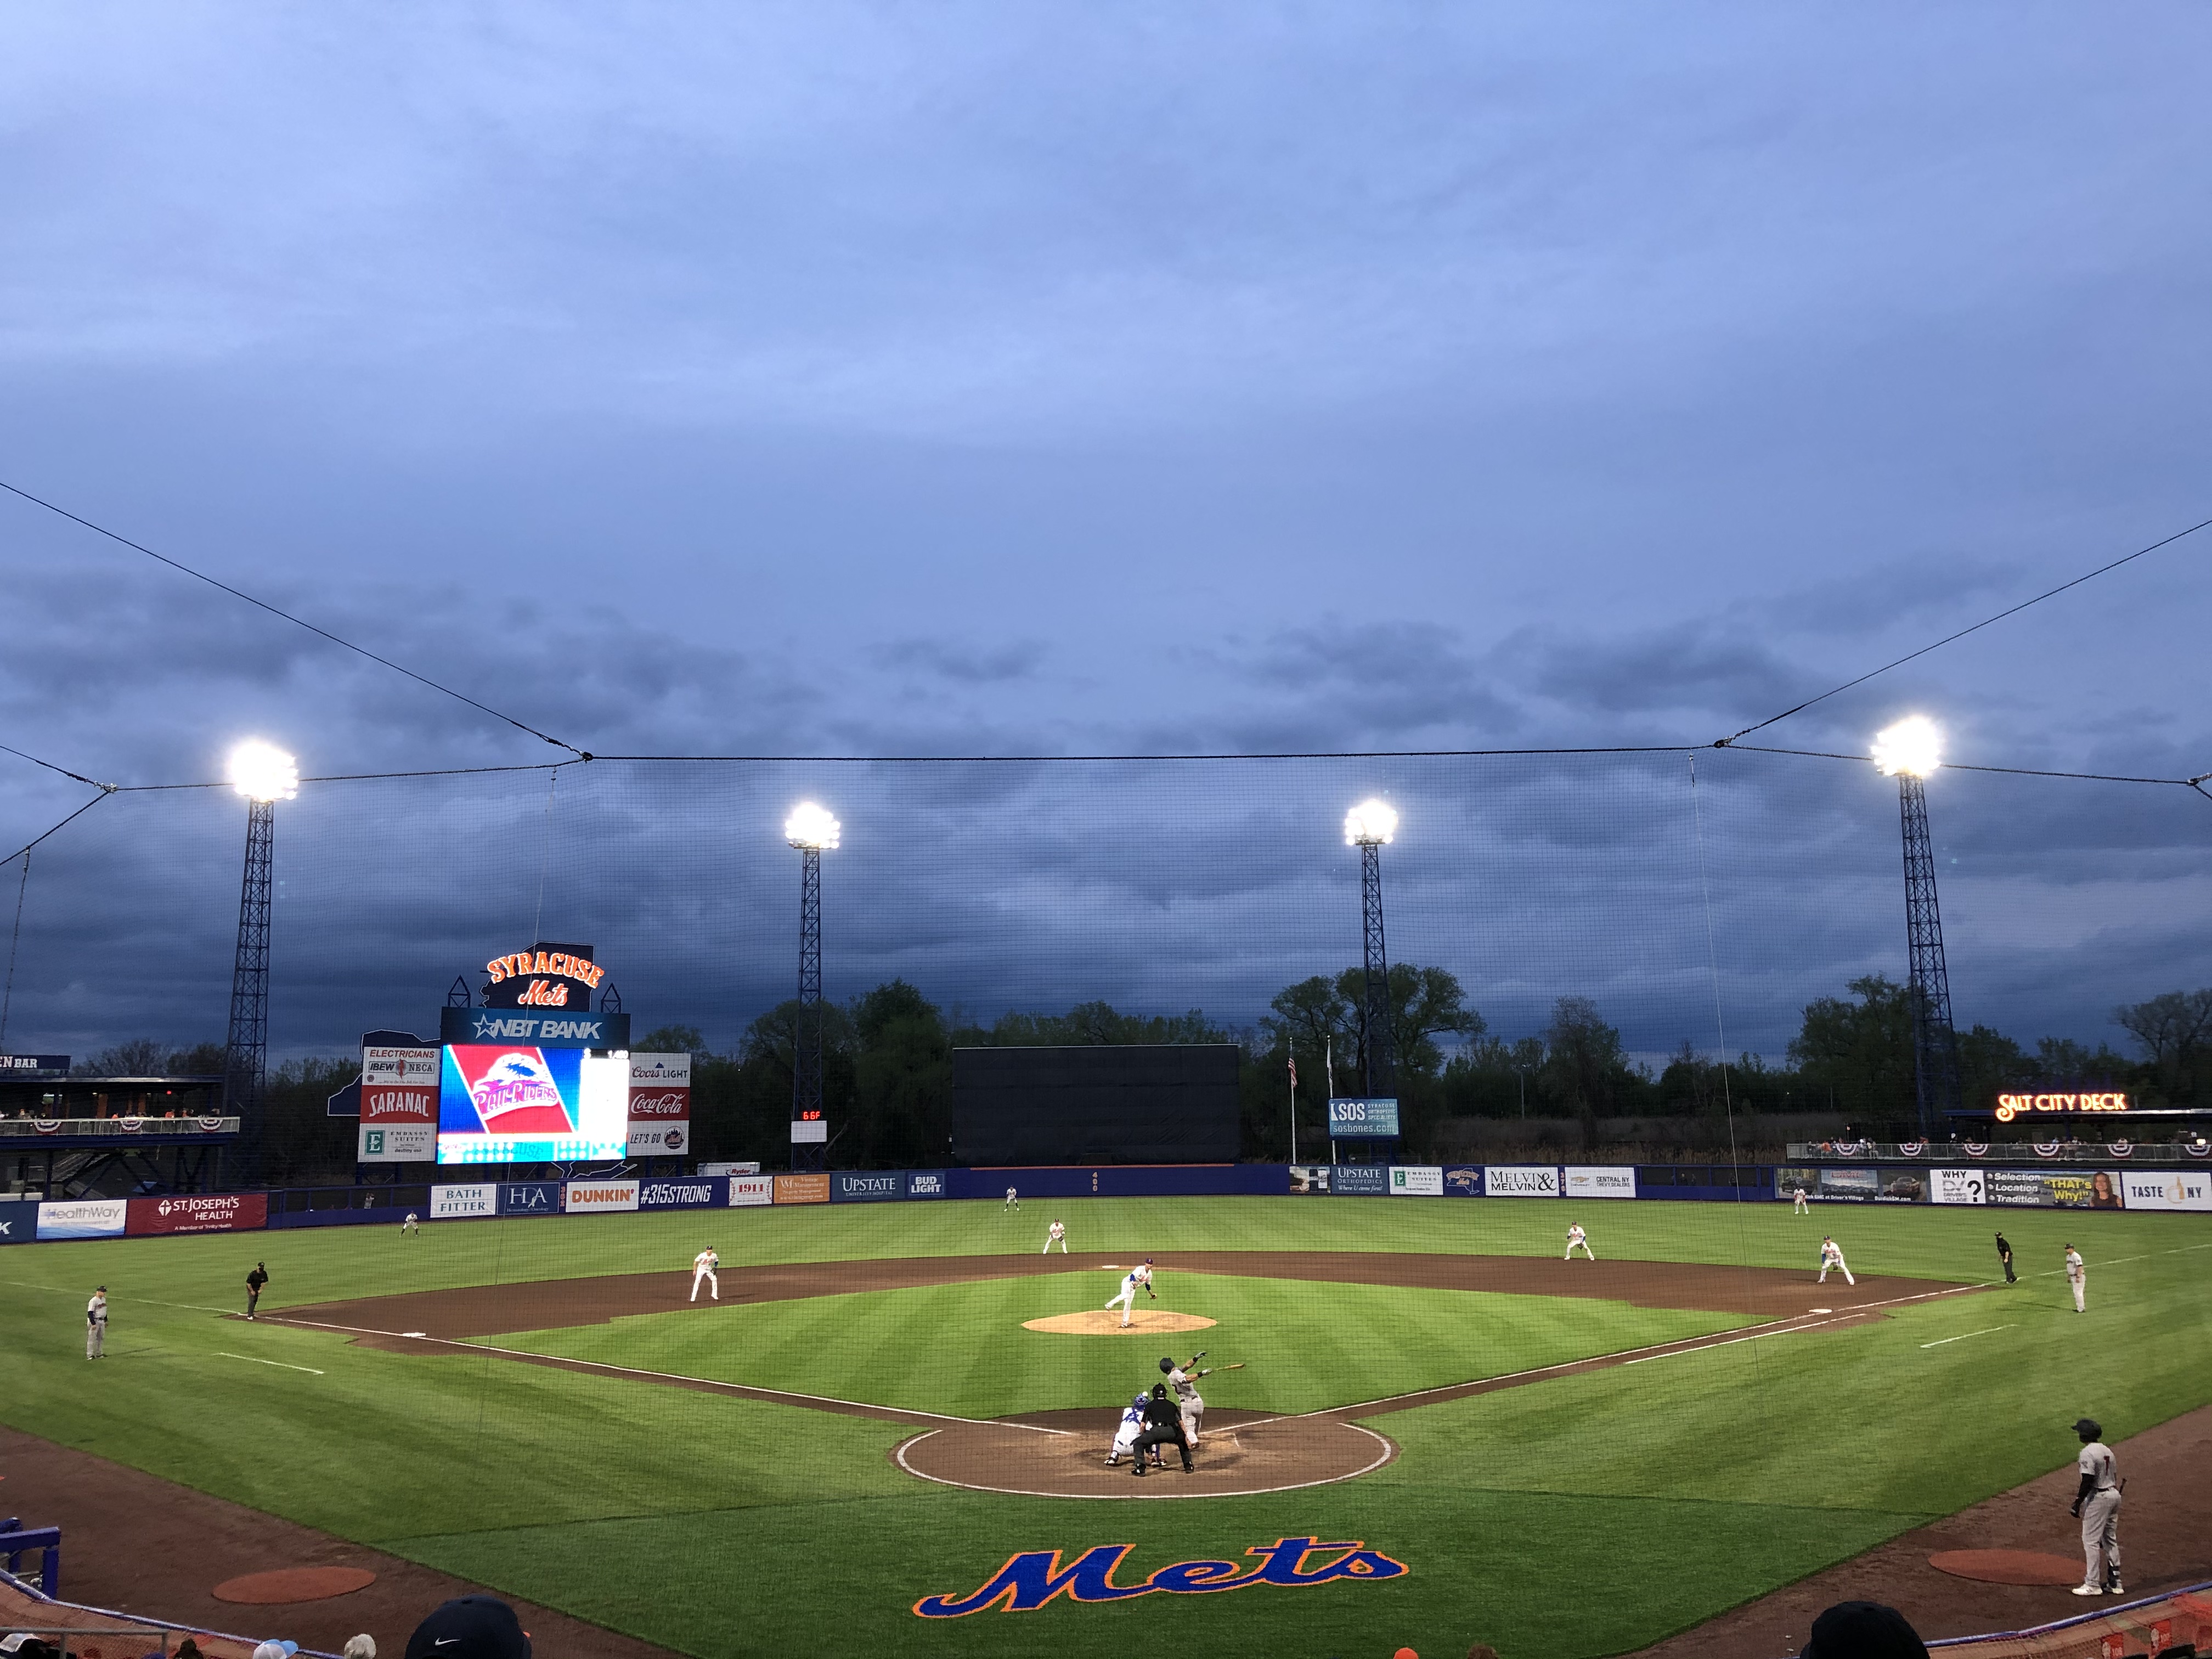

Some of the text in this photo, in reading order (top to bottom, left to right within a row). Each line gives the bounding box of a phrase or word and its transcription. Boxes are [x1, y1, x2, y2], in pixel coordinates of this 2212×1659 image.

[487, 951, 605, 989] SYRACUSE
[517, 979, 569, 1006] Mets
[494, 1019, 603, 1040] NBT BANK
[370, 1049, 435, 1058] ELECTRICIANS
[14, 1058, 38, 1068] BAR
[370, 1063, 433, 1072] IBEW NECA
[632, 1066, 688, 1079] Coors LIGHT
[369, 1092, 430, 1118] SARANAC
[631, 1093, 686, 1114] Coca-Cola
[1995, 1093, 2128, 1122] SALT CITY DECK
[1338, 1103, 1365, 1121] SOS
[1333, 1124, 1396, 1133] sosbones.com
[630, 1133, 650, 1144] LET'S
[651, 1133, 661, 1143] GO
[1338, 1167, 1381, 1178] UPSTATE
[1491, 1171, 1542, 1183] MELVIN
[1994, 1172, 2041, 1181] Selection
[842, 1177, 896, 1192] UPSTATE
[915, 1176, 938, 1185] BUD
[738, 1183, 764, 1193] 1911
[911, 1184, 941, 1193] LIGHT
[1967, 1180, 1982, 1203] ?
[1995, 1183, 2038, 1192] Location
[2131, 1186, 2202, 1198] TASTE NY
[446, 1189, 482, 1199] BATH
[572, 1188, 635, 1203] DUNKIN'
[640, 1184, 712, 1204] #315STRONG
[1996, 1194, 2040, 1203] Tradition
[173, 1196, 240, 1213] ST. JOSEPH'S
[440, 1201, 486, 1212] FITTER
[195, 1210, 233, 1221] HEALTH
[912, 1536, 1409, 1618] Mets
